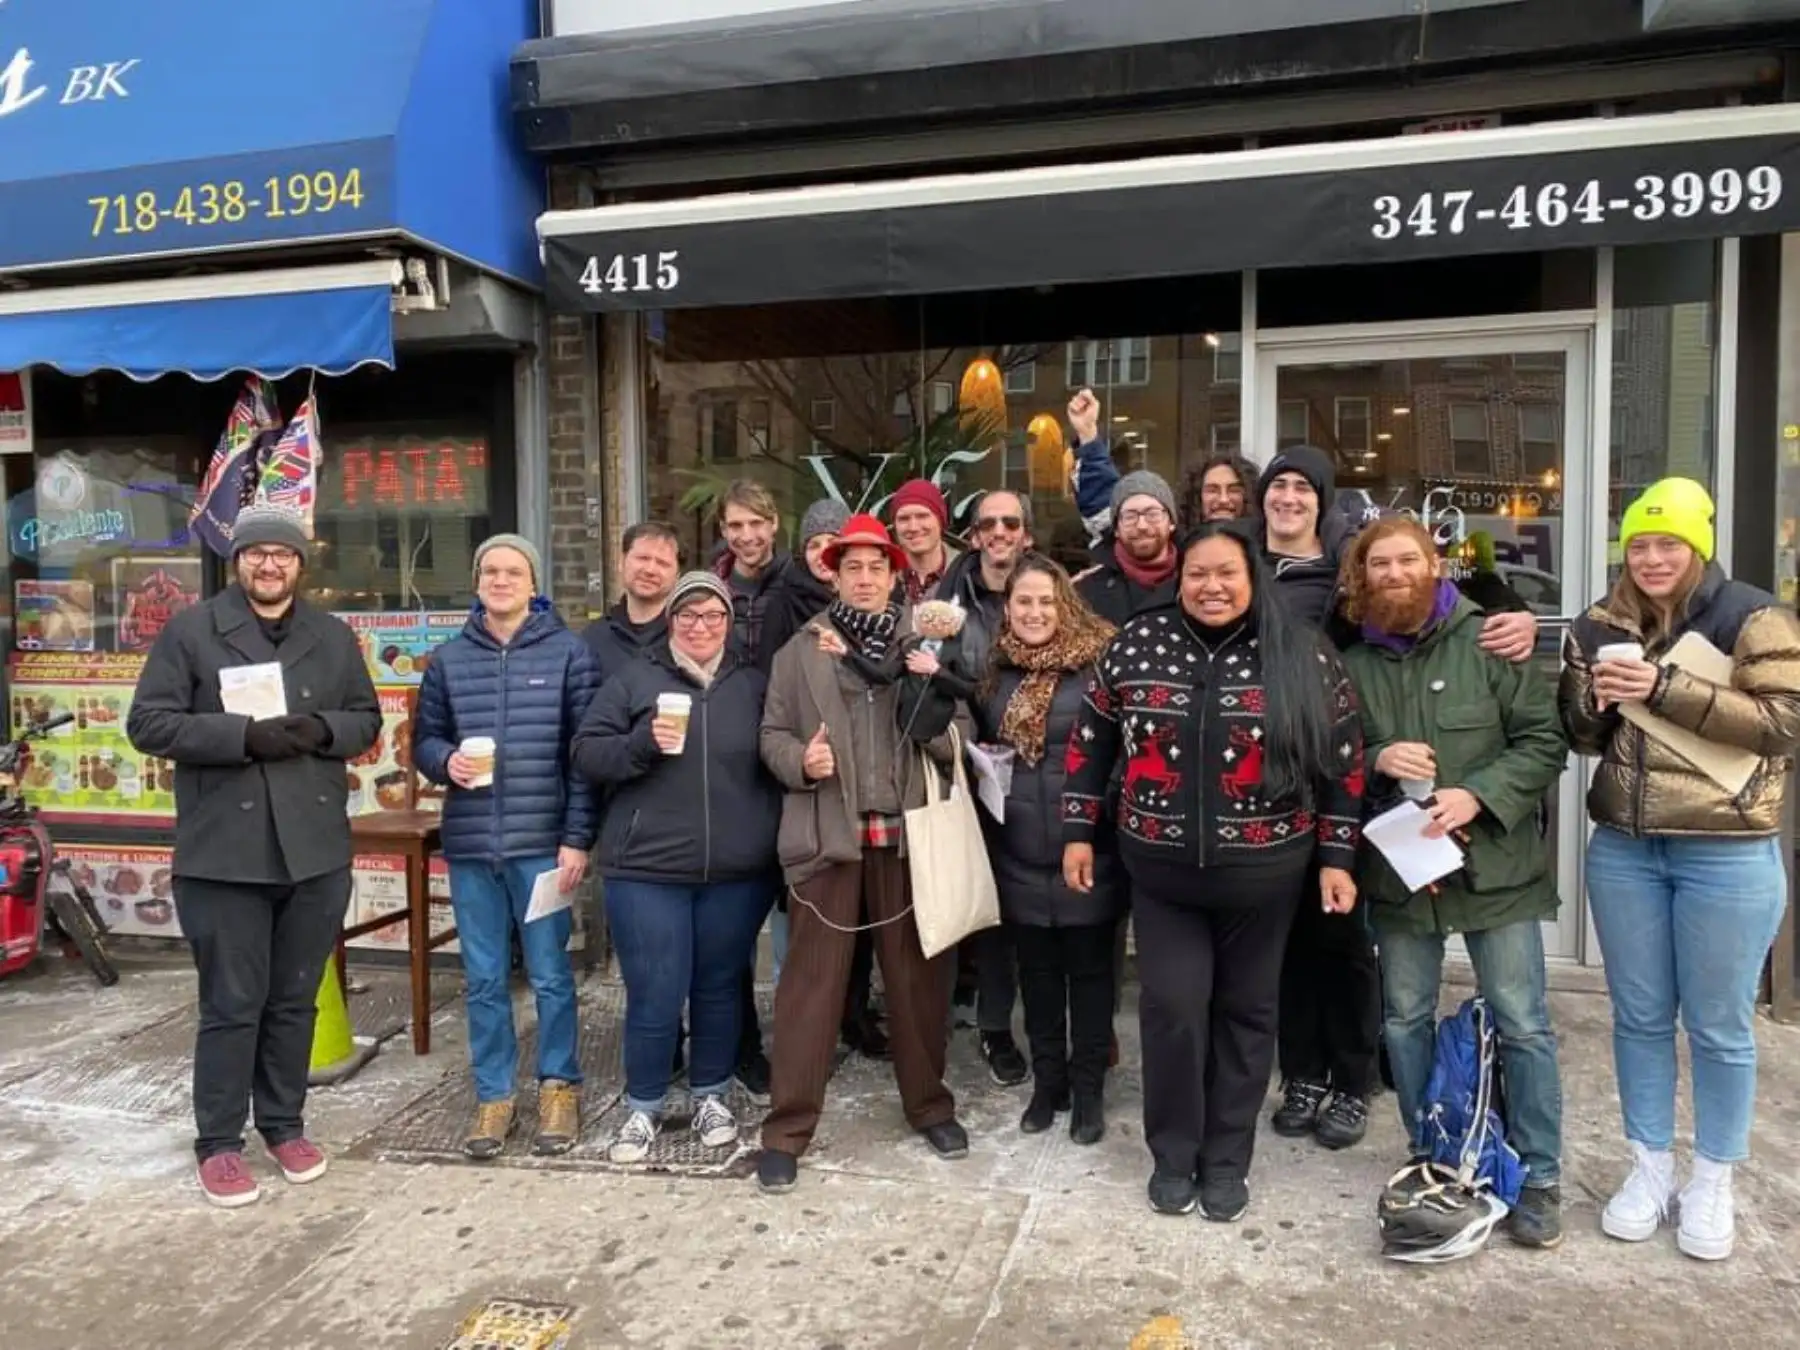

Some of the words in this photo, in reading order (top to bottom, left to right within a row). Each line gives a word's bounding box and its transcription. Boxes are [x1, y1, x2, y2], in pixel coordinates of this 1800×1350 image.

[59, 58, 143, 105] BK
[88, 167, 365, 238] 718-438-1994
[1371, 164, 1784, 240] 347-464-3999
[578, 250, 680, 293] 4415
